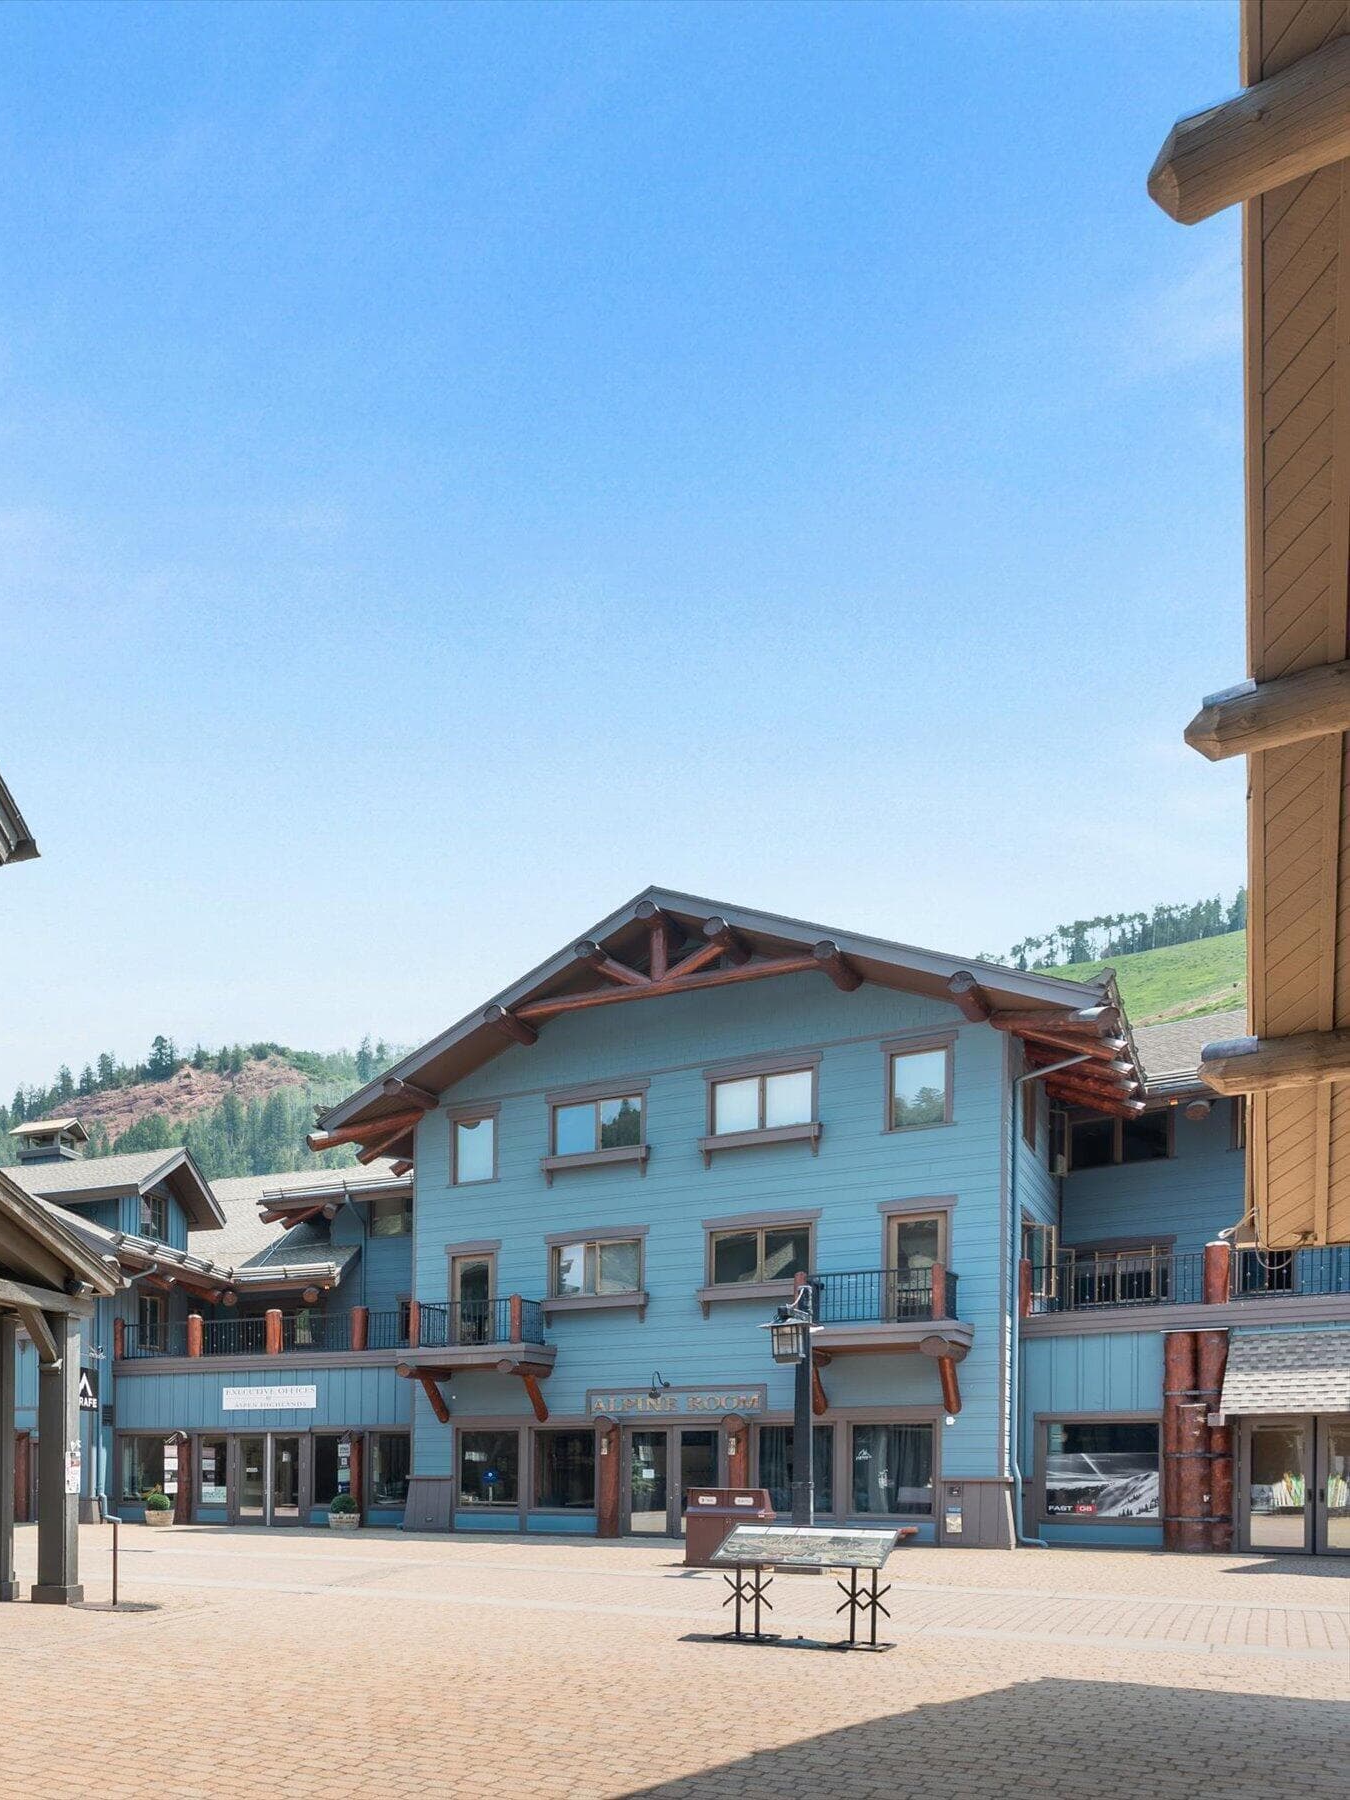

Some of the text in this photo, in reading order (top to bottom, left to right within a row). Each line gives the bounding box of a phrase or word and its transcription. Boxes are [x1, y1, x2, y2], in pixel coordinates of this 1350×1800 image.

[79, 1396, 98, 1408] RAFE
[592, 1394, 761, 1412] ALPINE ROOM
